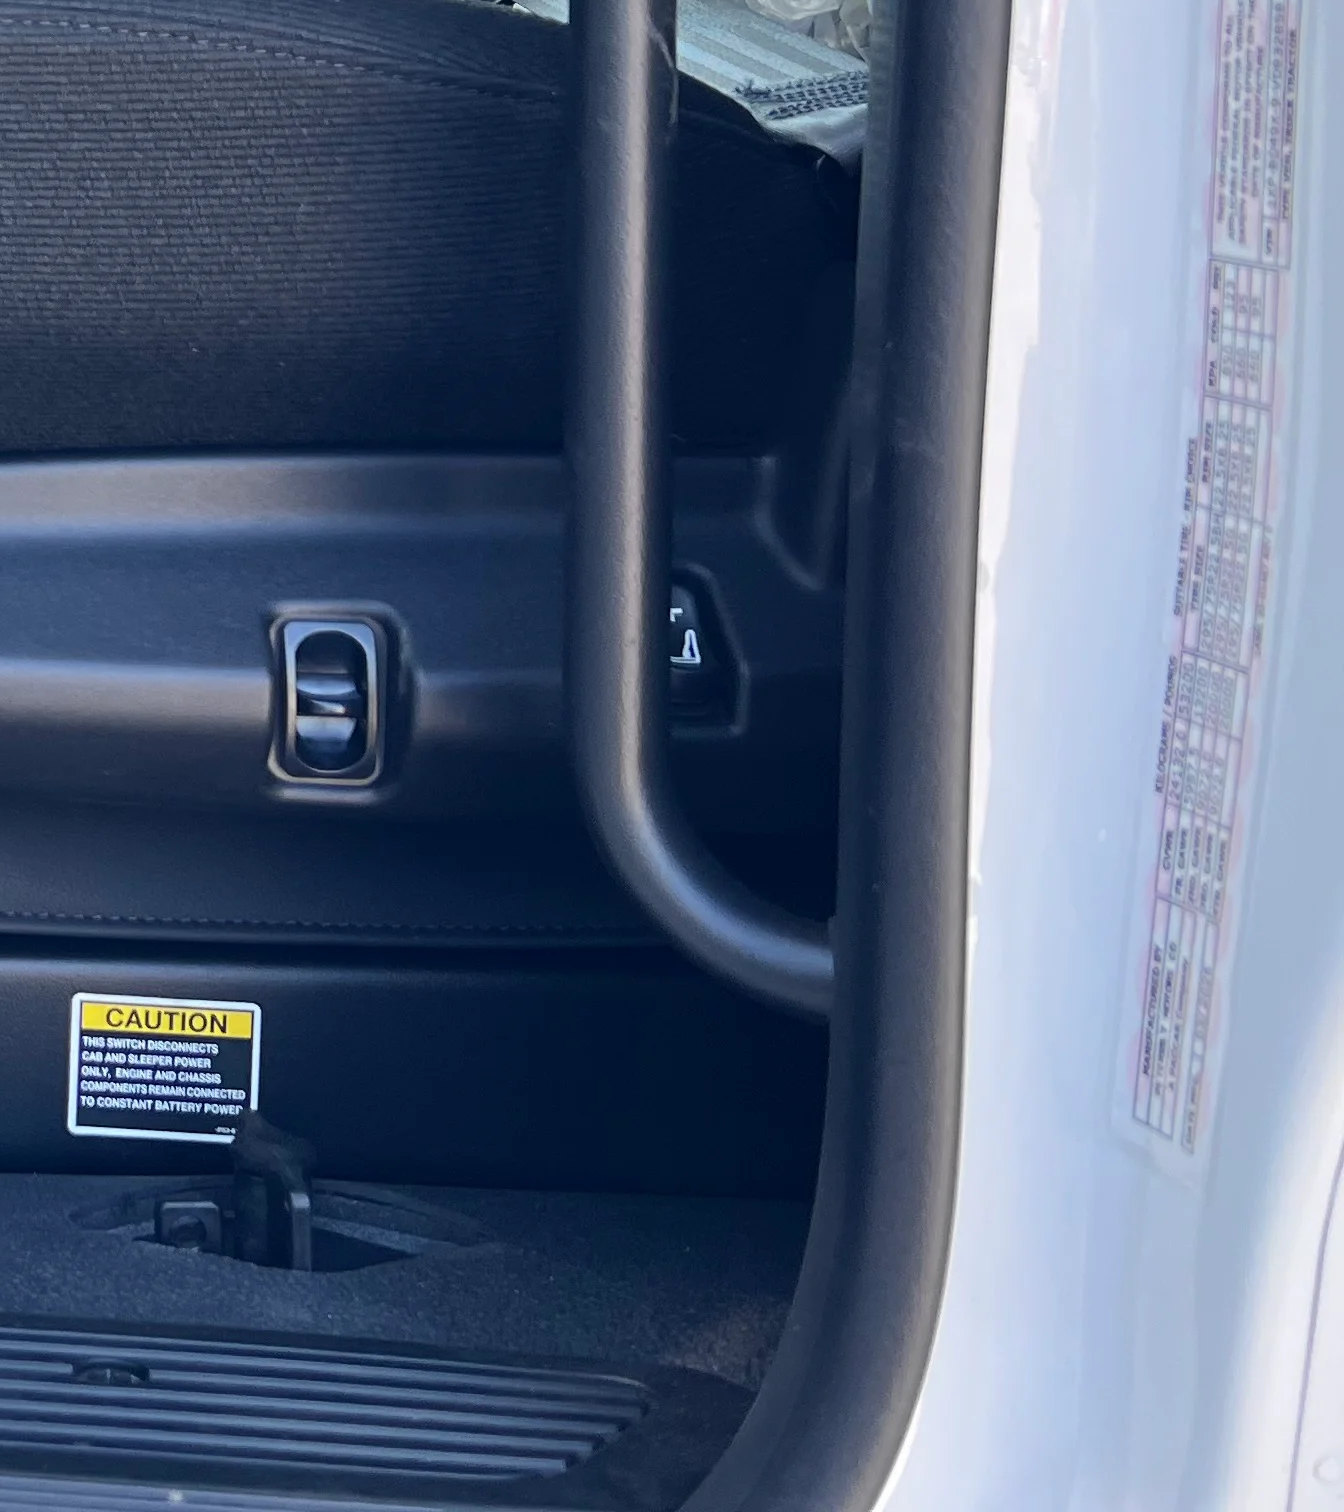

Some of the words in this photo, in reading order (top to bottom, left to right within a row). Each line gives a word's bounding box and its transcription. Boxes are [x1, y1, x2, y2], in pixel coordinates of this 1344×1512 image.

[106, 1008, 228, 1034] CAUTION
[82, 1036, 106, 1048] THIS
[106, 1037, 146, 1050] SWITCH
[148, 1040, 219, 1055] DISCONNECTS
[82, 1051, 103, 1063] CAB
[105, 1052, 126, 1065] AND
[128, 1053, 172, 1067] SLEEPER
[174, 1056, 211, 1069] POWER
[81, 1066, 111, 1079] ONLY,
[115, 1068, 153, 1081] ENGINE
[155, 1070, 176, 1082] AND
[178, 1071, 221, 1084] CHASSIS
[81, 1081, 148, 1095] COMPONENTS
[148, 1085, 186, 1097] REMAIN
[187, 1087, 246, 1100] CONNECTED
[80, 1095, 95, 1107] TO
[97, 1096, 153, 1110] CONSTANT
[155, 1100, 202, 1114] BATTERY
